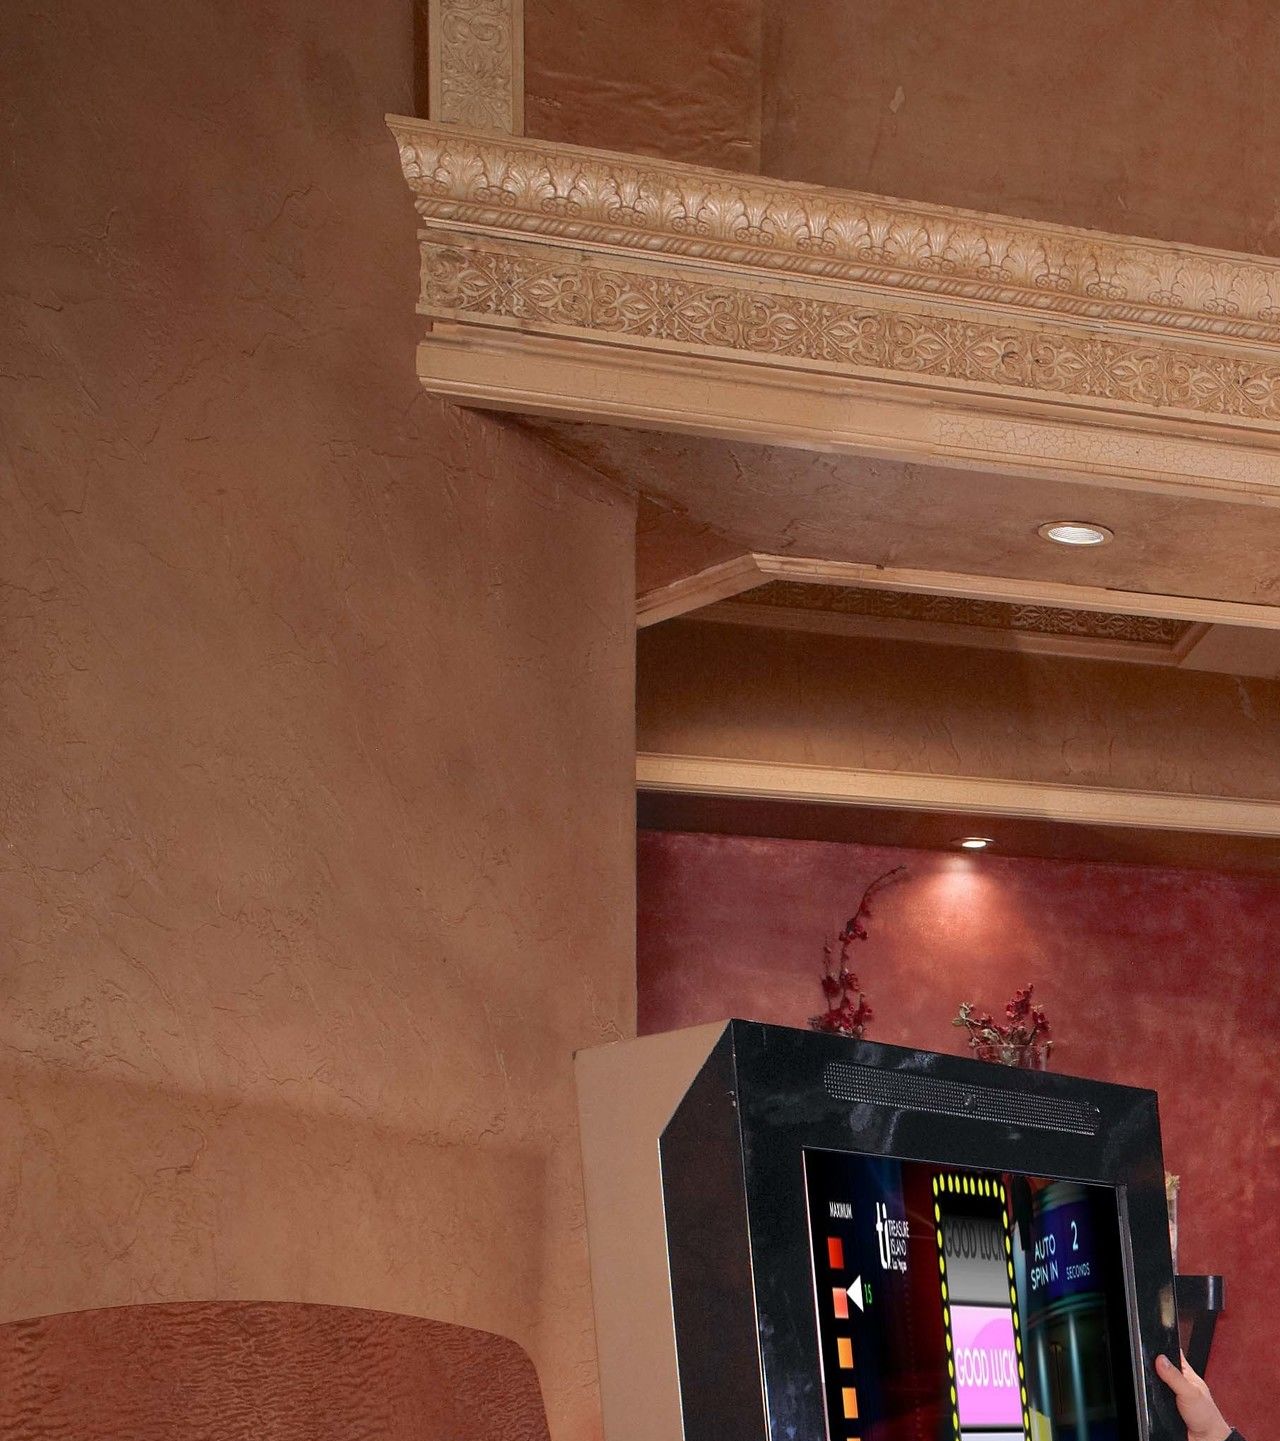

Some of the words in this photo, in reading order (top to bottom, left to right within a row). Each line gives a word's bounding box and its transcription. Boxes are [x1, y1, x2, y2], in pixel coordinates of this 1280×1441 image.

[829, 1201, 853, 1219] MAXIMUM
[888, 1220, 910, 1238] TREASURE
[944, 1220, 977, 1259] GOOD
[1070, 1220, 1079, 1251] 2
[890, 1239, 907, 1256] ISLAND
[1034, 1234, 1056, 1262] AUTO
[1031, 1266, 1049, 1290] SPIN
[1050, 1261, 1059, 1281] IN
[1066, 1262, 1091, 1280] SECONDS
[954, 1347, 989, 1387] GOOD
[990, 1348, 1018, 1388] LUCK
